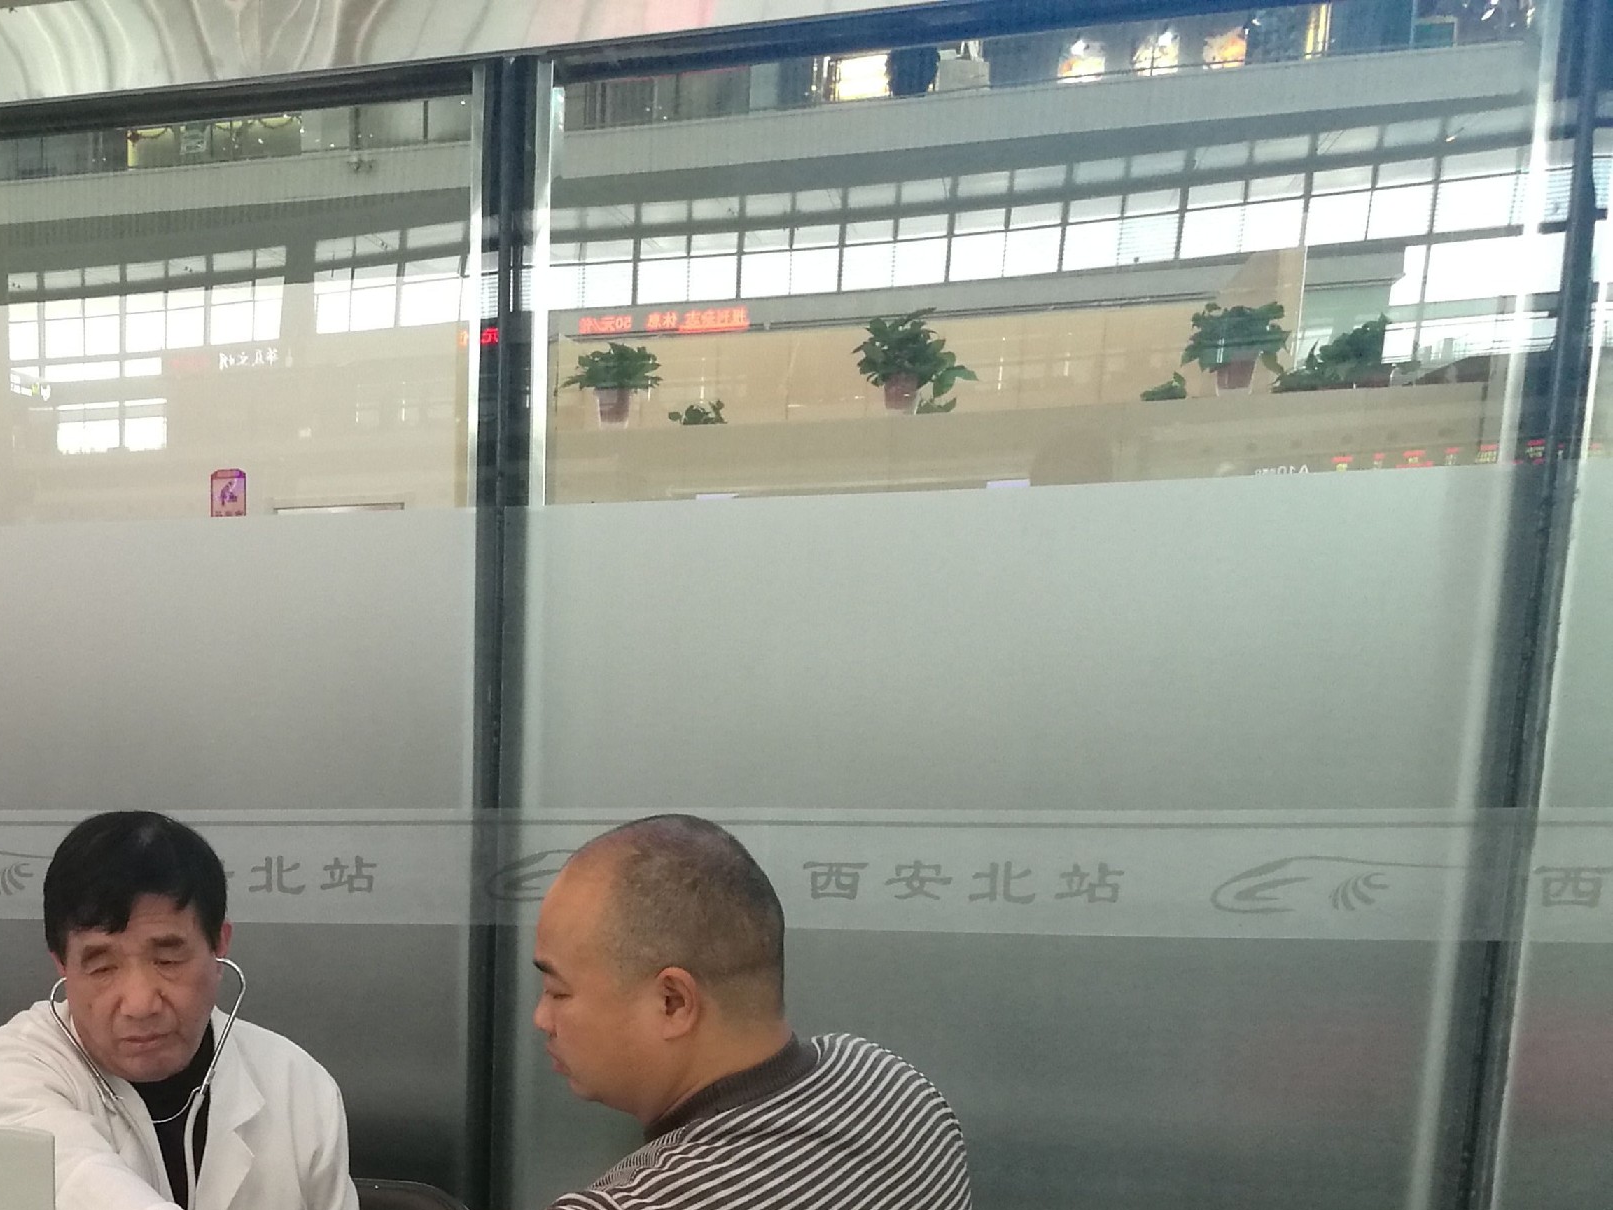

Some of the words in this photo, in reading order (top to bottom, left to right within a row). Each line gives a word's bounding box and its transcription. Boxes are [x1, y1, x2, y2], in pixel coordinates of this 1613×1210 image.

[225, 854, 378, 896] 北站
[802, 859, 1126, 906] 西安北站
